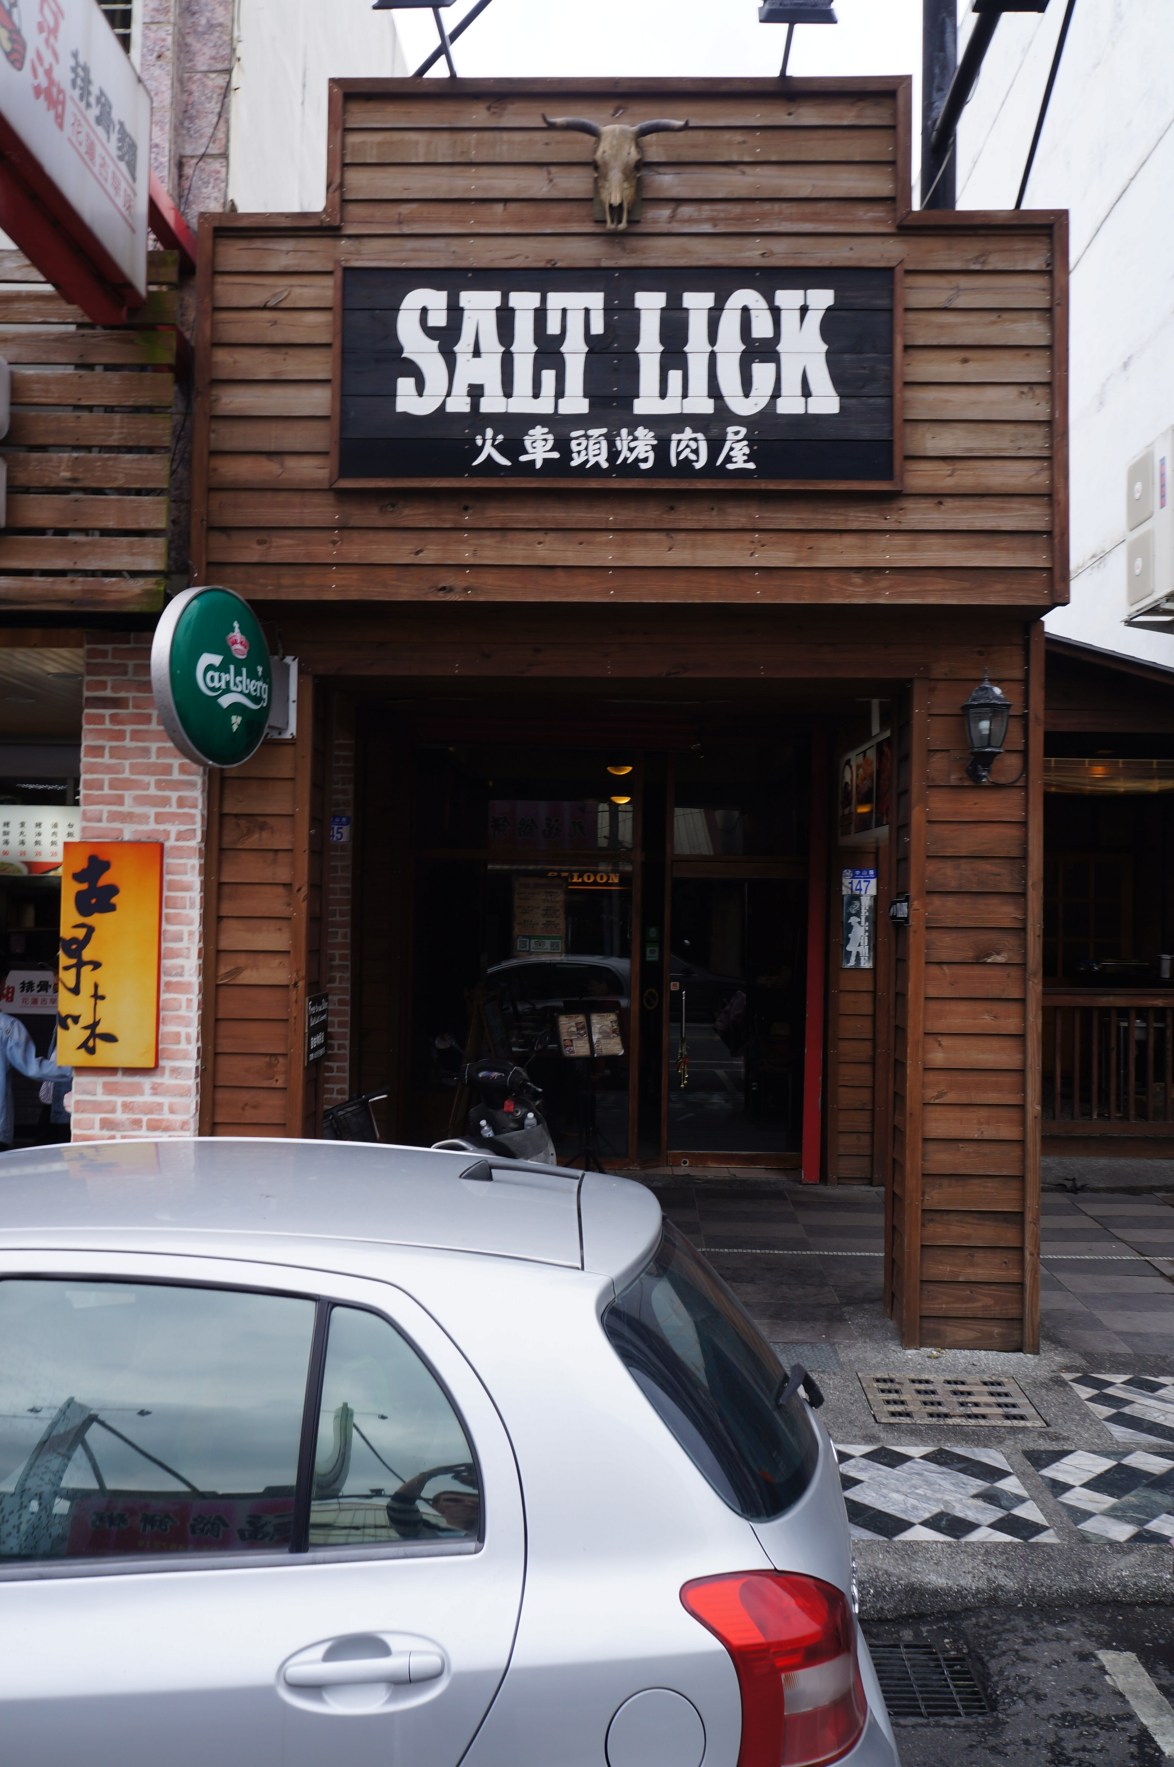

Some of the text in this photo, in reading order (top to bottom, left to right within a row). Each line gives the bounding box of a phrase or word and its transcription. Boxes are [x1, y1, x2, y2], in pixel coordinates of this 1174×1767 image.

[396, 288, 840, 415] SALT LICK
[471, 426, 757, 469] 火車頭烤肉屋
[196, 652, 269, 709] Carlsberg
[848, 880, 871, 895] 147
[57, 854, 120, 1055] 古早味
